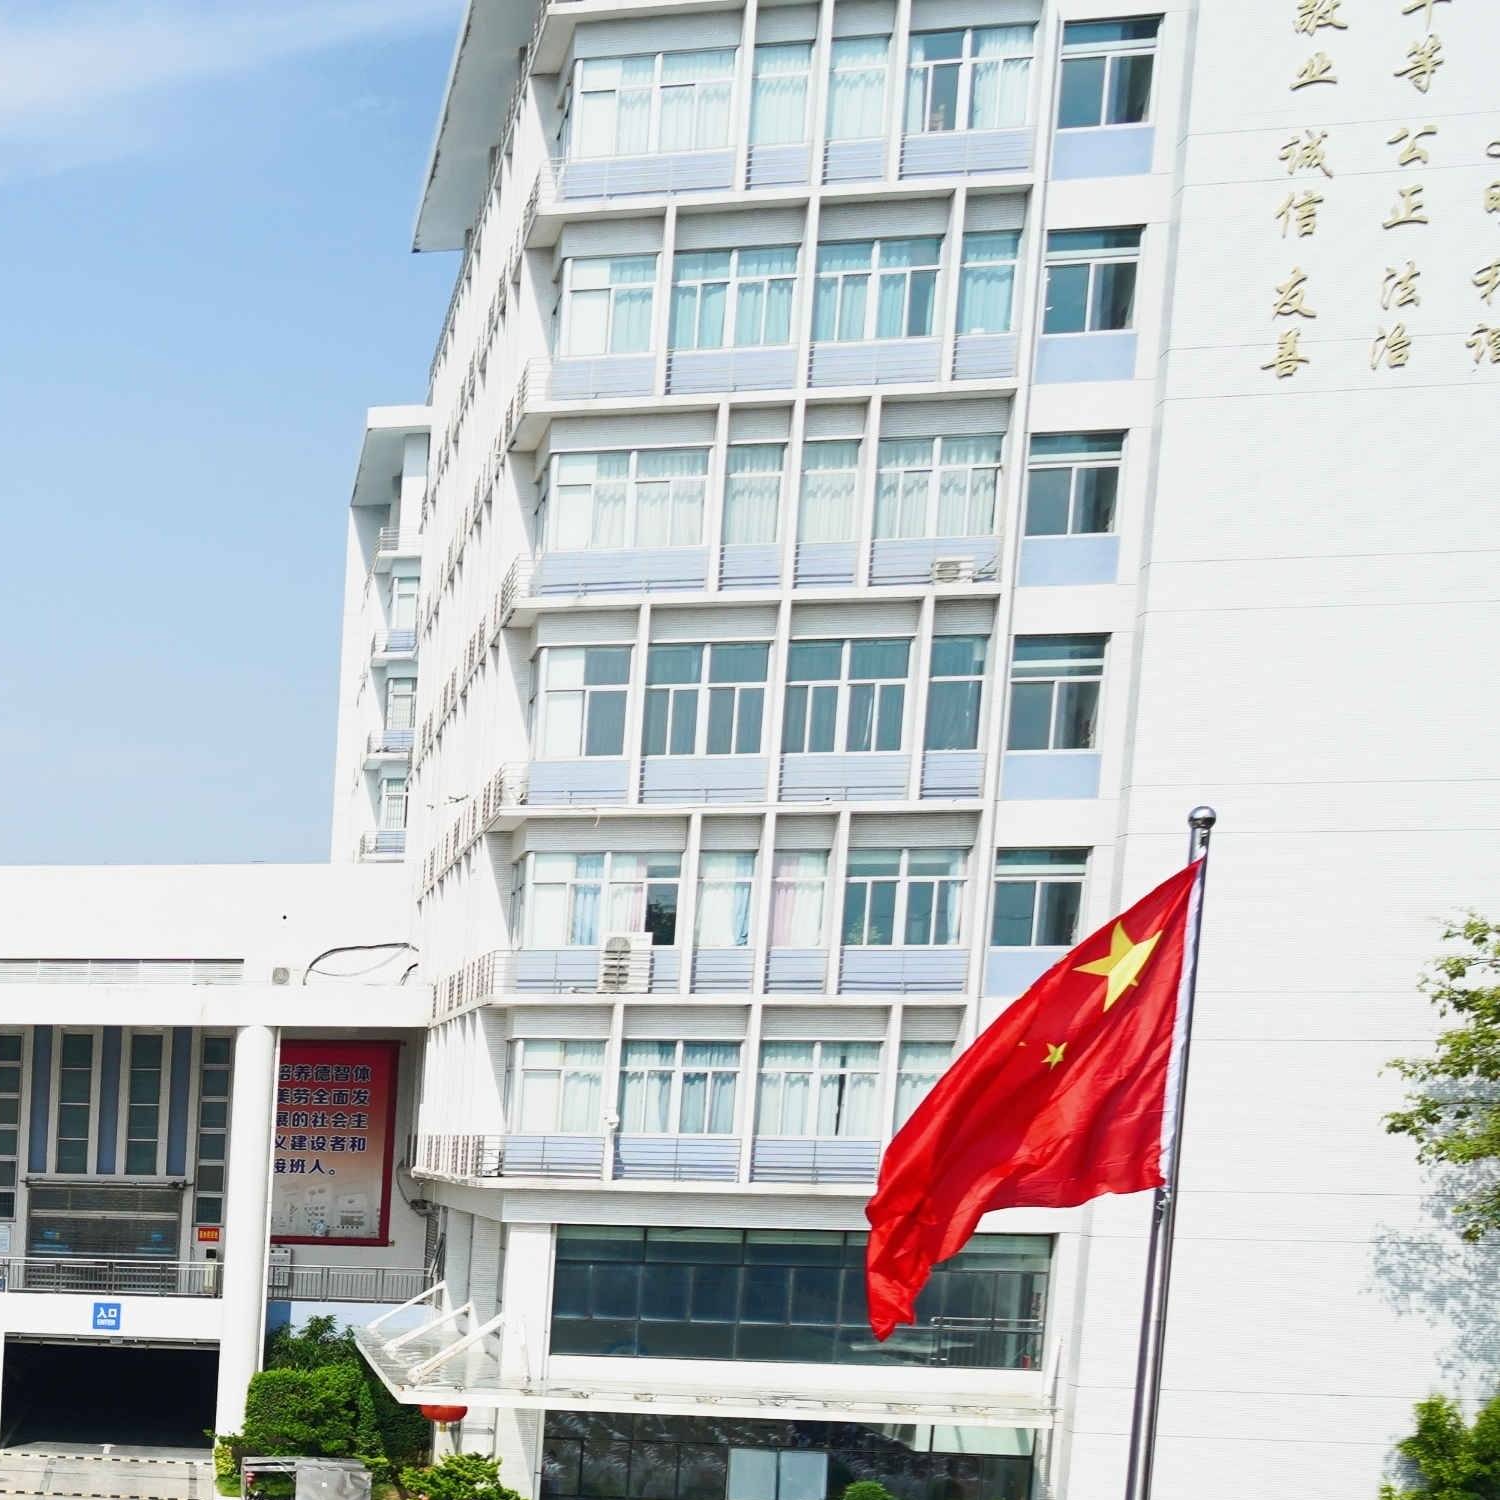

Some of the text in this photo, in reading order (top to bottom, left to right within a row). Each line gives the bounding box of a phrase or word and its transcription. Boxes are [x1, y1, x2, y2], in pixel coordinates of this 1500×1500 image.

[1274, 129, 1335, 239] 诚信
[1382, 124, 1439, 231] 公正
[1259, 265, 1319, 379] 友善
[1369, 260, 1423, 371] 法治
[96, 1306, 118, 1319] 入口
